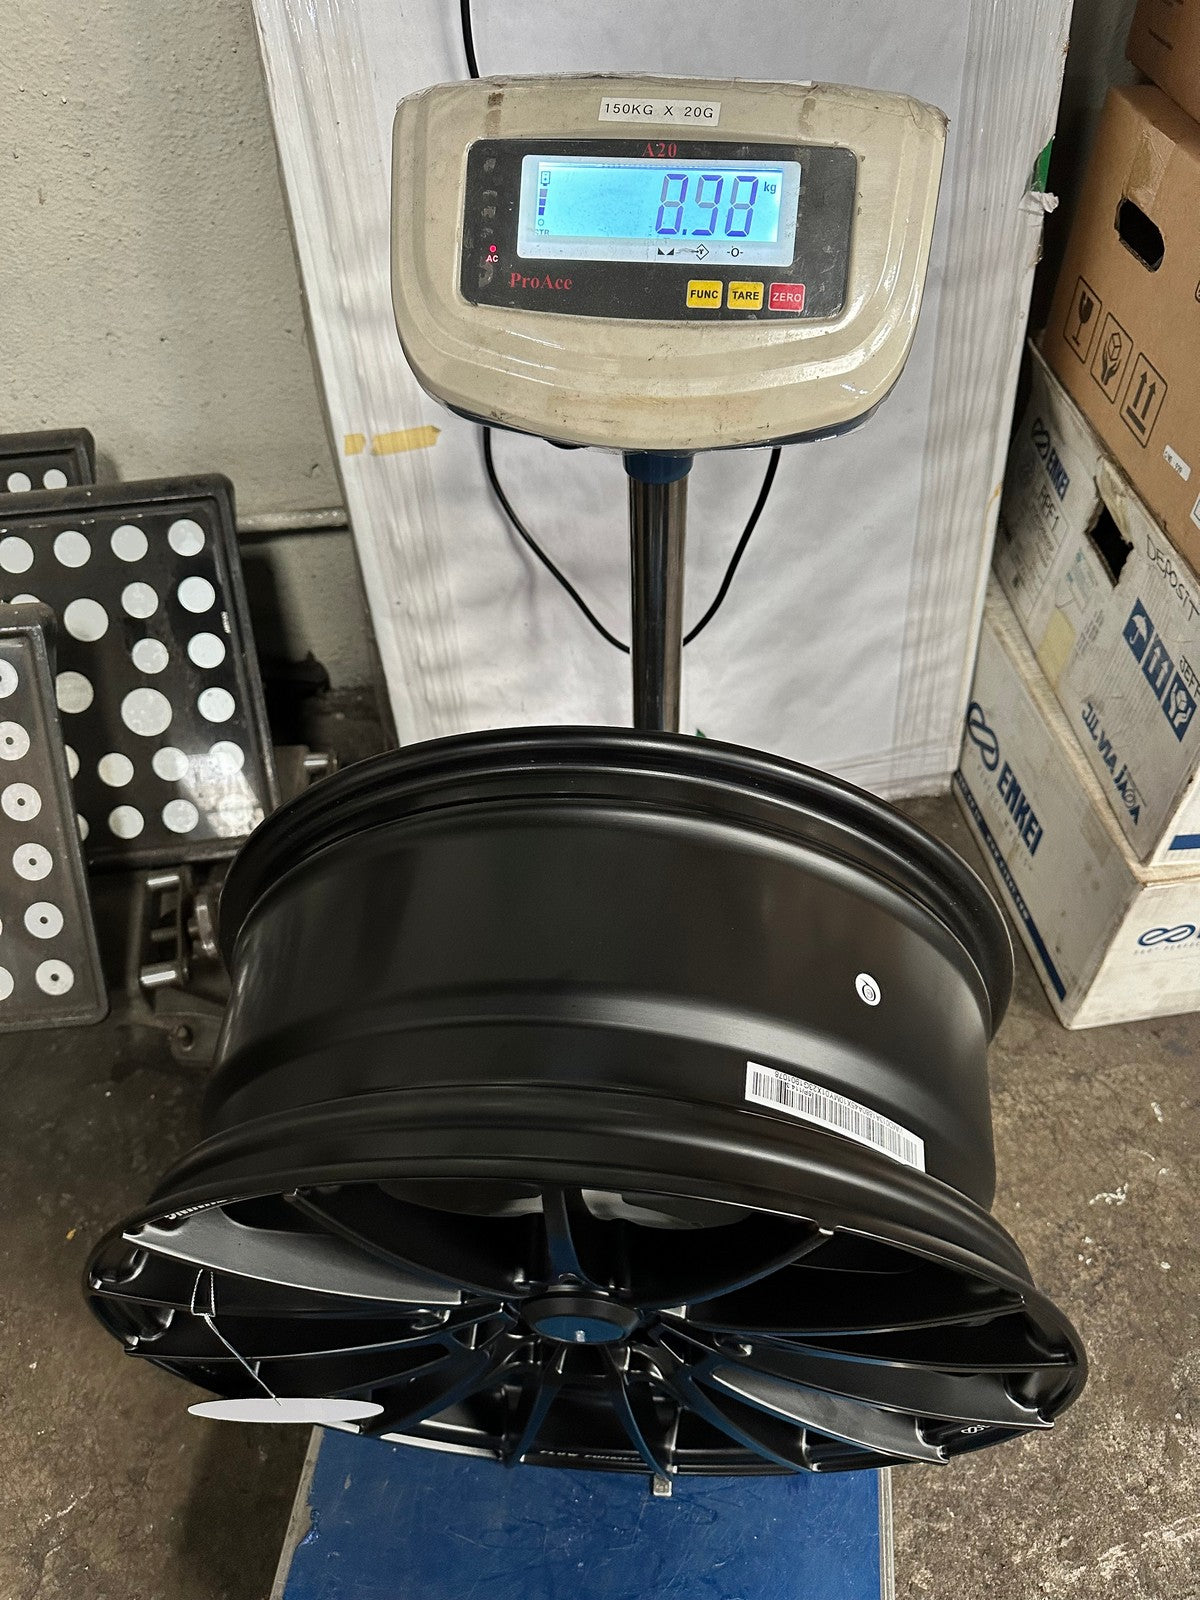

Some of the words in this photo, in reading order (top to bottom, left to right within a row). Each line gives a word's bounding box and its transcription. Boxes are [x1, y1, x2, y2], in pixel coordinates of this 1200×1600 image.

[604, 102, 653, 116] 150KG
[664, 105, 674, 116] X
[684, 106, 714, 119] 20G
[642, 142, 677, 158] A20
[655, 173, 759, 237] 8.98
[763, 182, 777, 194] kg
[486, 254, 499, 263] AC
[509, 271, 574, 291] ProAce
[690, 289, 719, 299] FUNC
[732, 290, 760, 301] TARE
[772, 292, 802, 302] ZERO
[1147, 533, 1200, 622] DEPOSIT
[998, 760, 1043, 857] ENKEI
